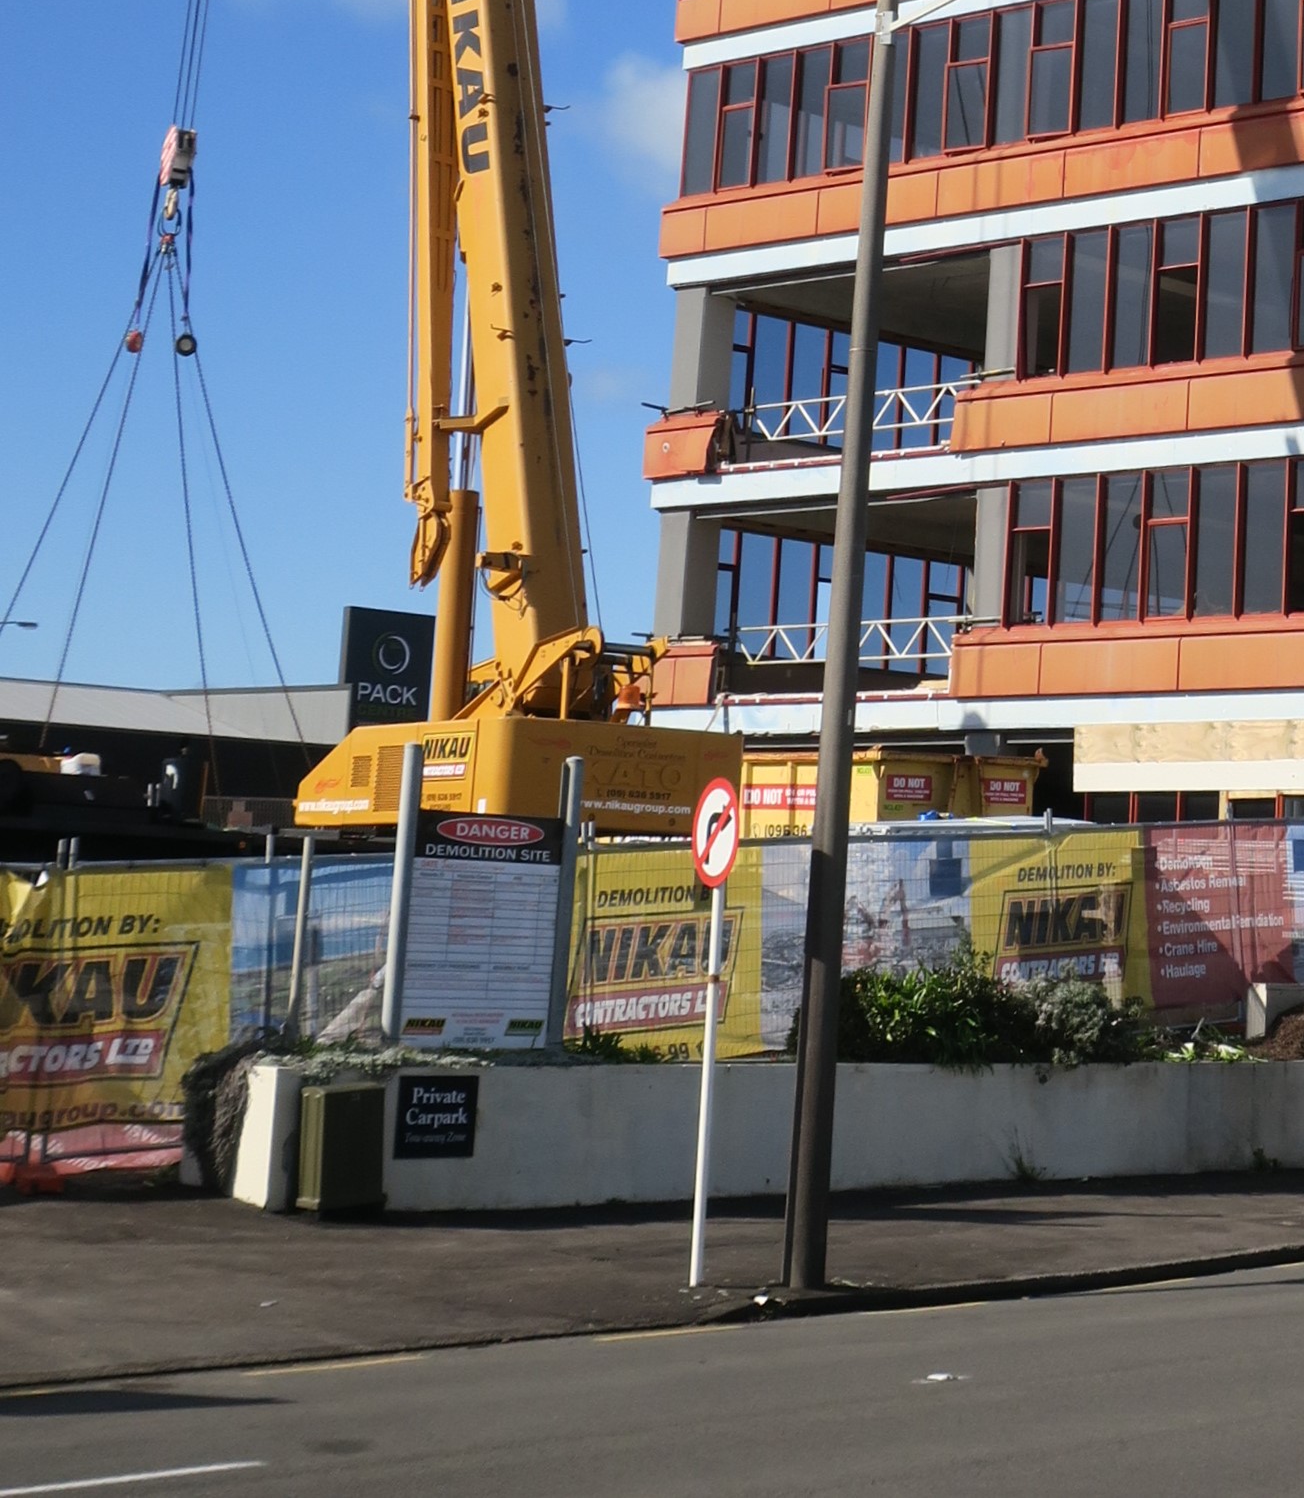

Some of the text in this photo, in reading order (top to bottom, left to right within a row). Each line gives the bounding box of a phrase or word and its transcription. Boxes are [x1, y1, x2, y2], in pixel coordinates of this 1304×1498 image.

[357, 682, 418, 706] PACK
[424, 737, 471, 759] NIKAU
[893, 777, 926, 789] DO NOT
[990, 781, 1020, 792] DO NOT
[762, 789, 783, 805] NOT
[456, 823, 530, 840] DANGER
[425, 843, 551, 862] DEMOLITION SITE
[1017, 862, 1116, 883] DEMOLITION BY:
[1160, 878, 1207, 893] Asbestos
[597, 886, 695, 908] DEMOLITION
[1161, 898, 1211, 915] Recycling
[0, 914, 161, 943] OLITION BY:
[1005, 892, 1125, 947] NIKAU
[1162, 914, 1236, 936] Environmental
[1164, 940, 1218, 957] Crane Hire
[1166, 963, 1207, 979] Haulage
[105, 1038, 155, 1065] LTD
[412, 1087, 467, 1104] Private
[405, 1107, 468, 1129] Carpark
